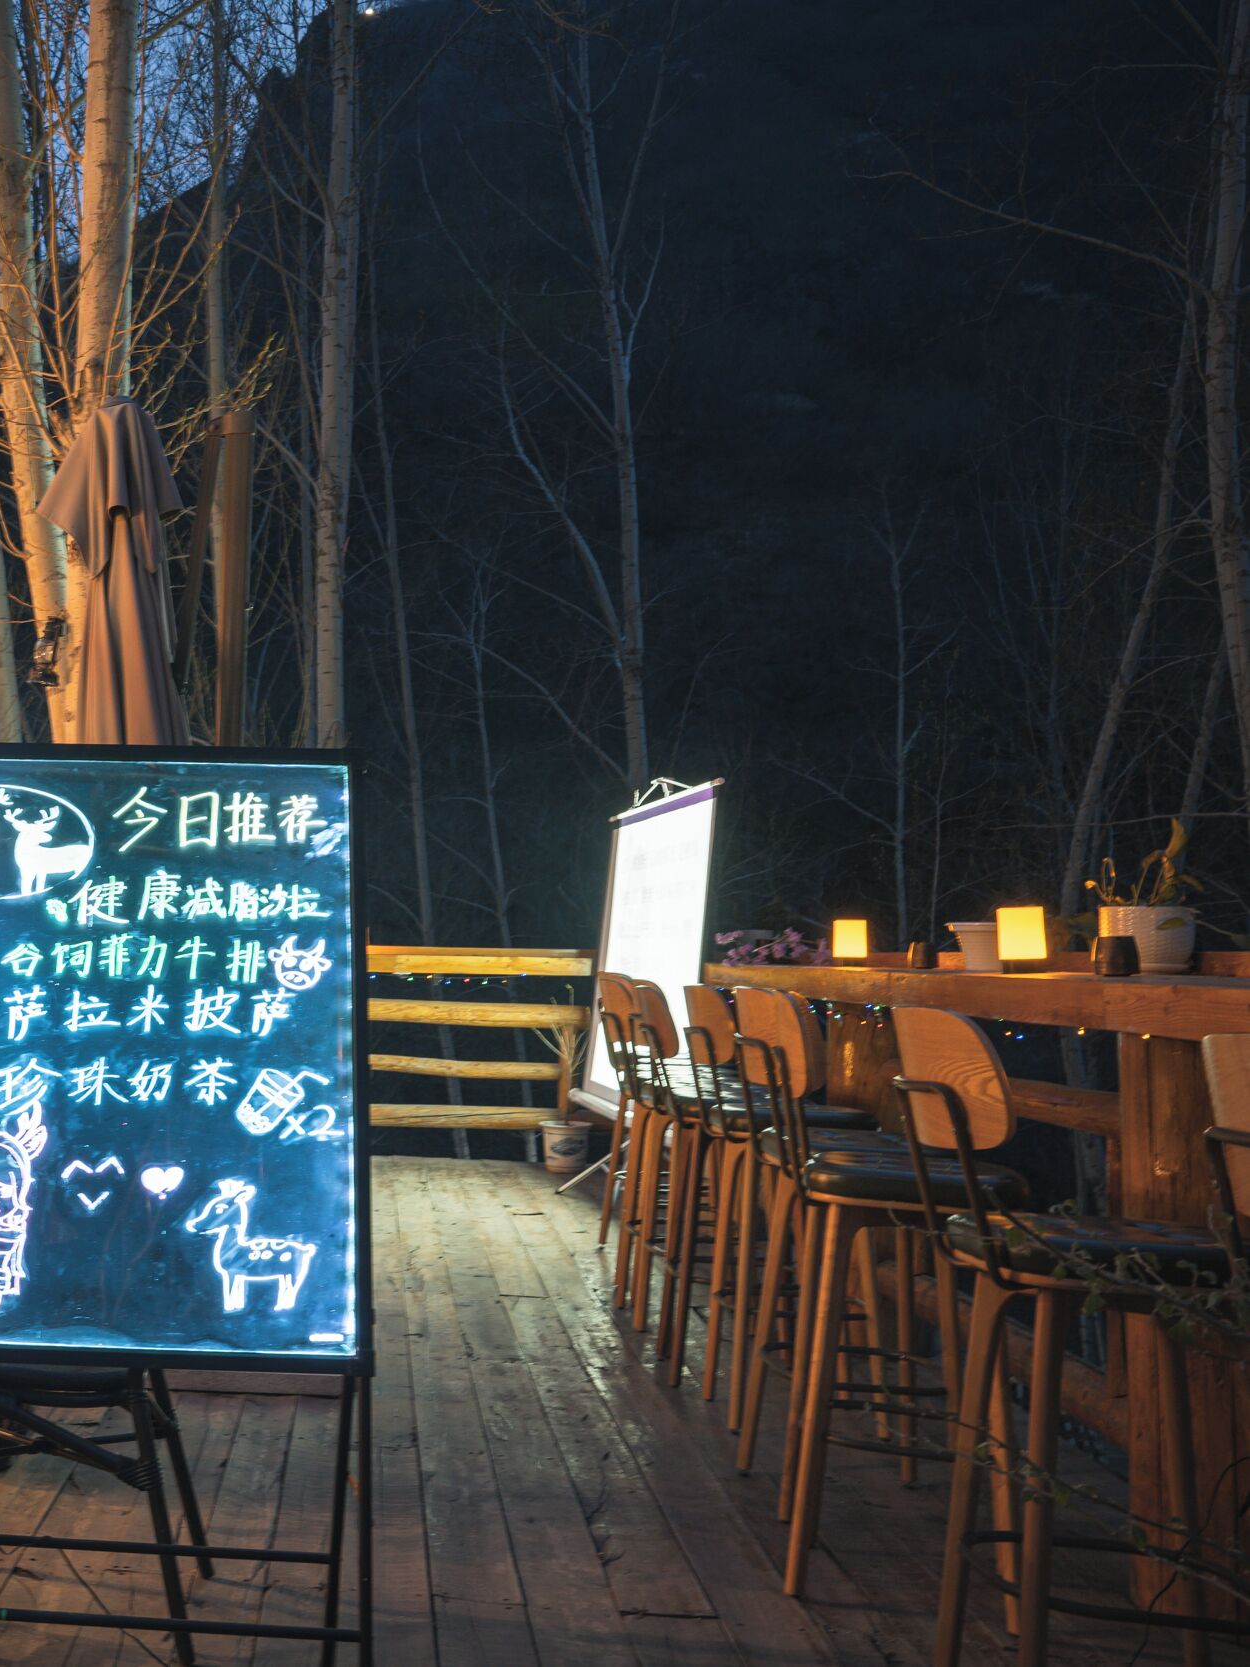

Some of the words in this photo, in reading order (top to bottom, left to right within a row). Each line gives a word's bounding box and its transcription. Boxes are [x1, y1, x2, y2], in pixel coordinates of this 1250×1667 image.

[112, 786, 328, 852] 今日推荐
[68, 869, 331, 925] 健康减脂沙拉
[0, 933, 267, 983] 谷饲菲力牛排
[3, 985, 296, 1040] 萨拉米披萨
